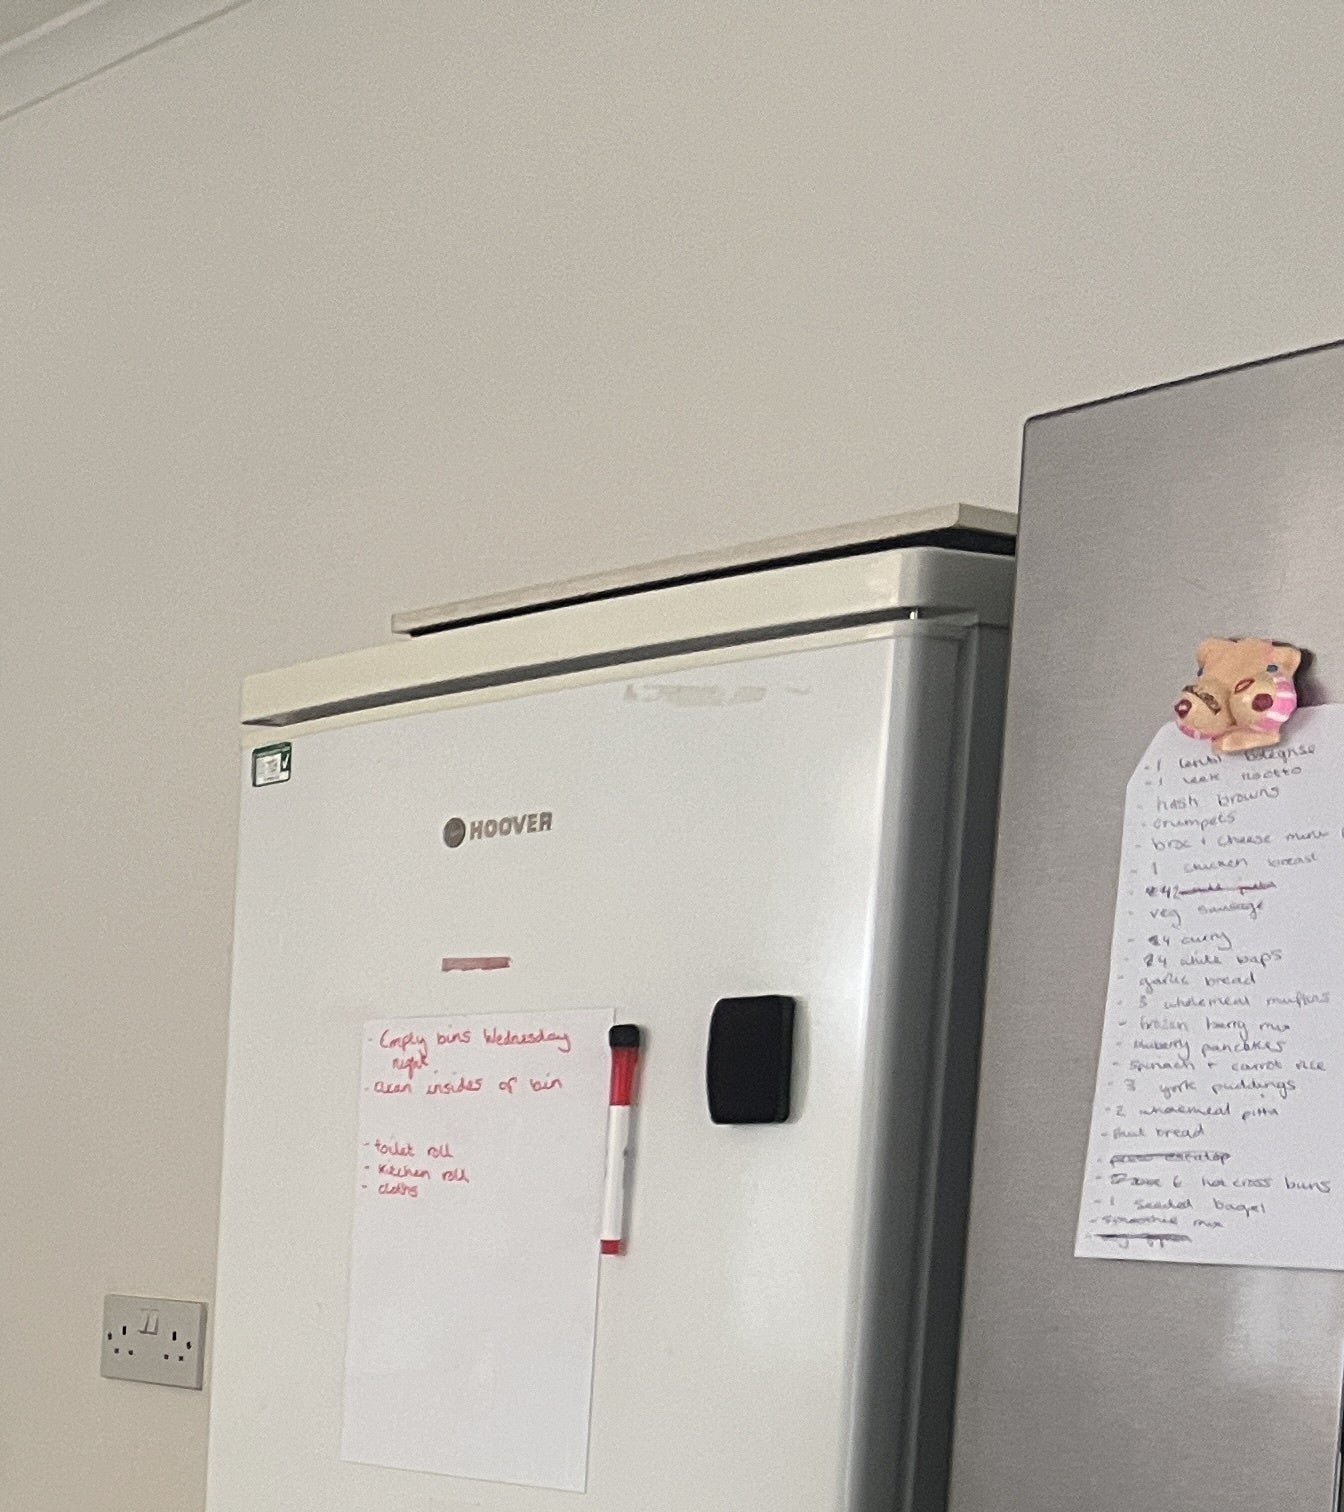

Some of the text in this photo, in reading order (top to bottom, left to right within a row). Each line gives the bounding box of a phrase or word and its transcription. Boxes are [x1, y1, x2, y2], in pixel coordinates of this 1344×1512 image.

[1157, 786, 1280, 812] hash browns
[470, 811, 553, 841] HOOVER
[1153, 811, 1236, 831] crumpets
[1204, 971, 1256, 987] bread
[483, 1027, 572, 1054] Wednesday
[498, 1076, 518, 1094] of
[529, 1072, 563, 1093] bin
[1211, 1079, 1297, 1100] puddings
[1156, 1123, 1205, 1139] bread
[374, 1139, 454, 1159] toilet roll
[1284, 1176, 1332, 1194] buns
